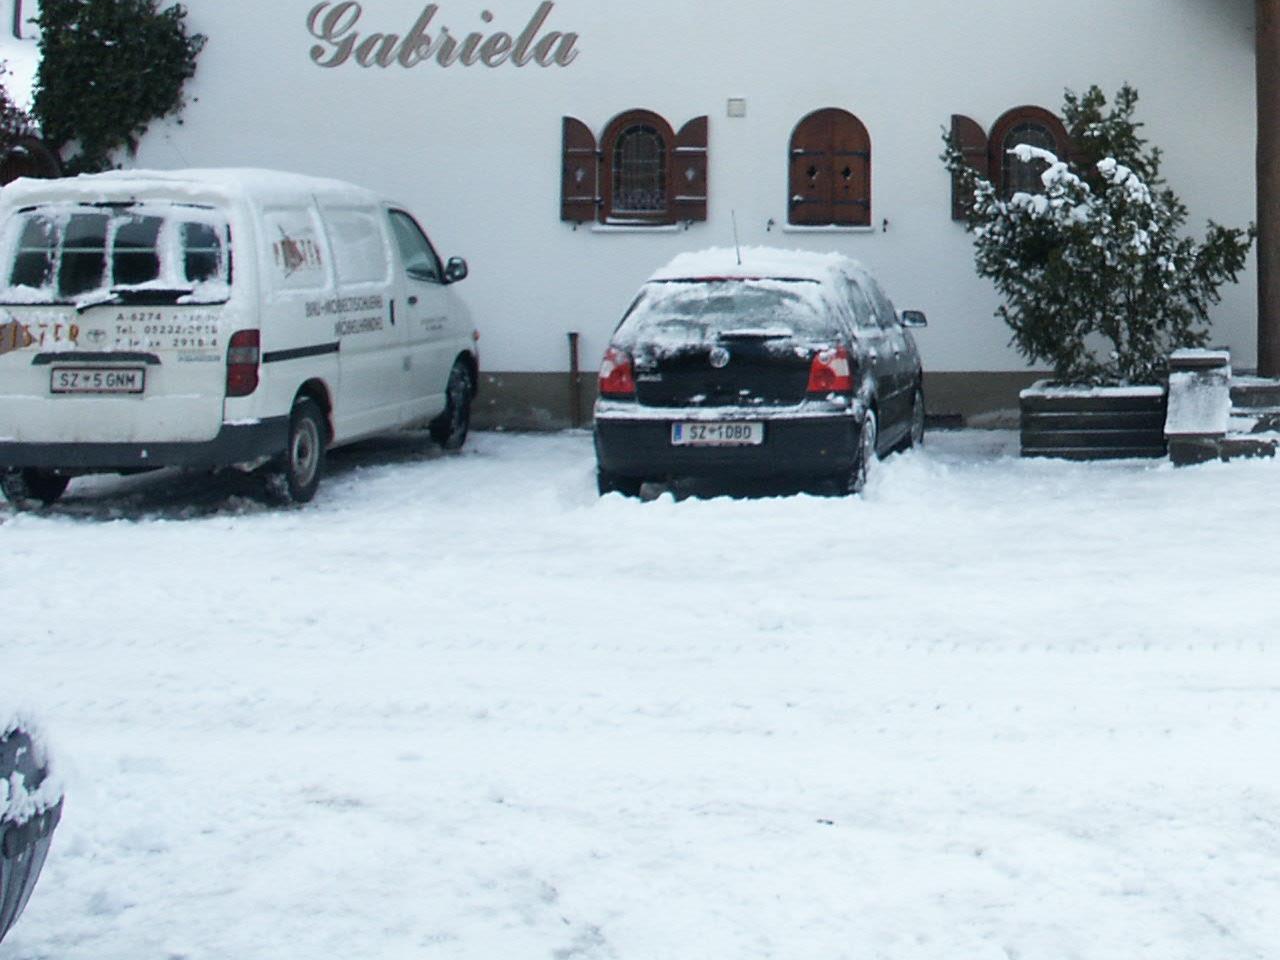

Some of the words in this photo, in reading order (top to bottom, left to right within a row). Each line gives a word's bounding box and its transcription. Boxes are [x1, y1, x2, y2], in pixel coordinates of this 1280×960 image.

[305, 0, 580, 68] Gabriela
[60, 372, 78, 387] SZ
[690, 424, 707, 440] SZ
